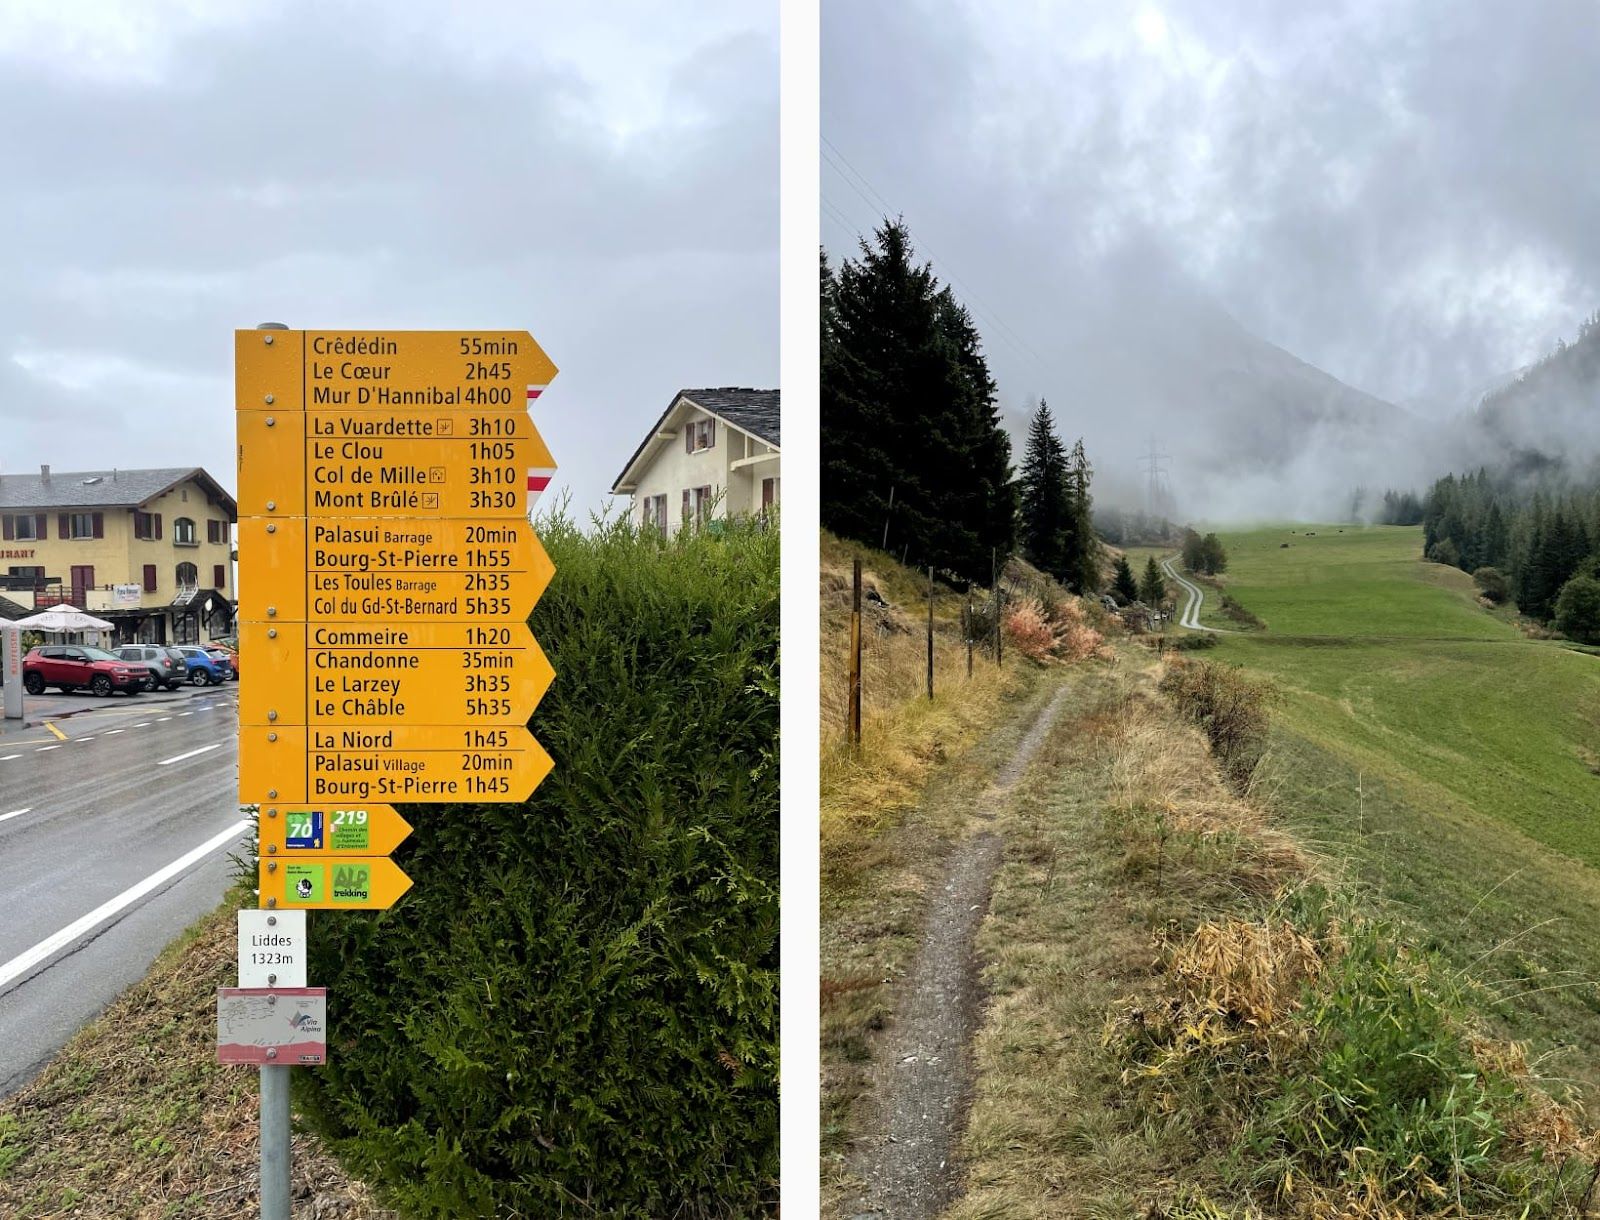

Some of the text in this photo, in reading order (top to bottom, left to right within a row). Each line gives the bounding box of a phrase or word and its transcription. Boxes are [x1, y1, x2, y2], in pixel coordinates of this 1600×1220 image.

[313, 337, 518, 355] Crêdédin 55min
[313, 362, 511, 380] Le Cœur 2h45
[313, 387, 511, 405] Mur D'Hannibal 4h00
[314, 418, 515, 436] La Vuardette 3h10
[314, 443, 515, 460] Le Clou 1h05
[314, 467, 515, 484] Col de Mille 3h10
[315, 491, 516, 508] Mont Brûlé 3h30
[315, 526, 517, 546] Palasui Barrage 20min
[315, 550, 510, 570] Bourg-St-Pierre 1h55
[315, 574, 510, 593] Les Toules Barrage 2h35
[315, 598, 510, 615] Col du Gd-St-Bernard 5h35
[315, 628, 510, 645] Commeire 1h20
[315, 652, 514, 668] Chandonne 35min
[316, 676, 510, 695] Le Larzey 3h35
[316, 699, 511, 716] Le Châble 5h35
[316, 731, 508, 748] La Niord 1h45
[316, 755, 513, 773] Palasui Village 20min
[316, 777, 509, 798] Bourg-St-Pierre 1h45
[334, 811, 367, 825] 219
[291, 823, 312, 838] 70
[334, 867, 367, 889] ALP
[334, 889, 367, 899] trekking
[252, 935, 292, 947] Liddes
[252, 952, 293, 965] 1323m
